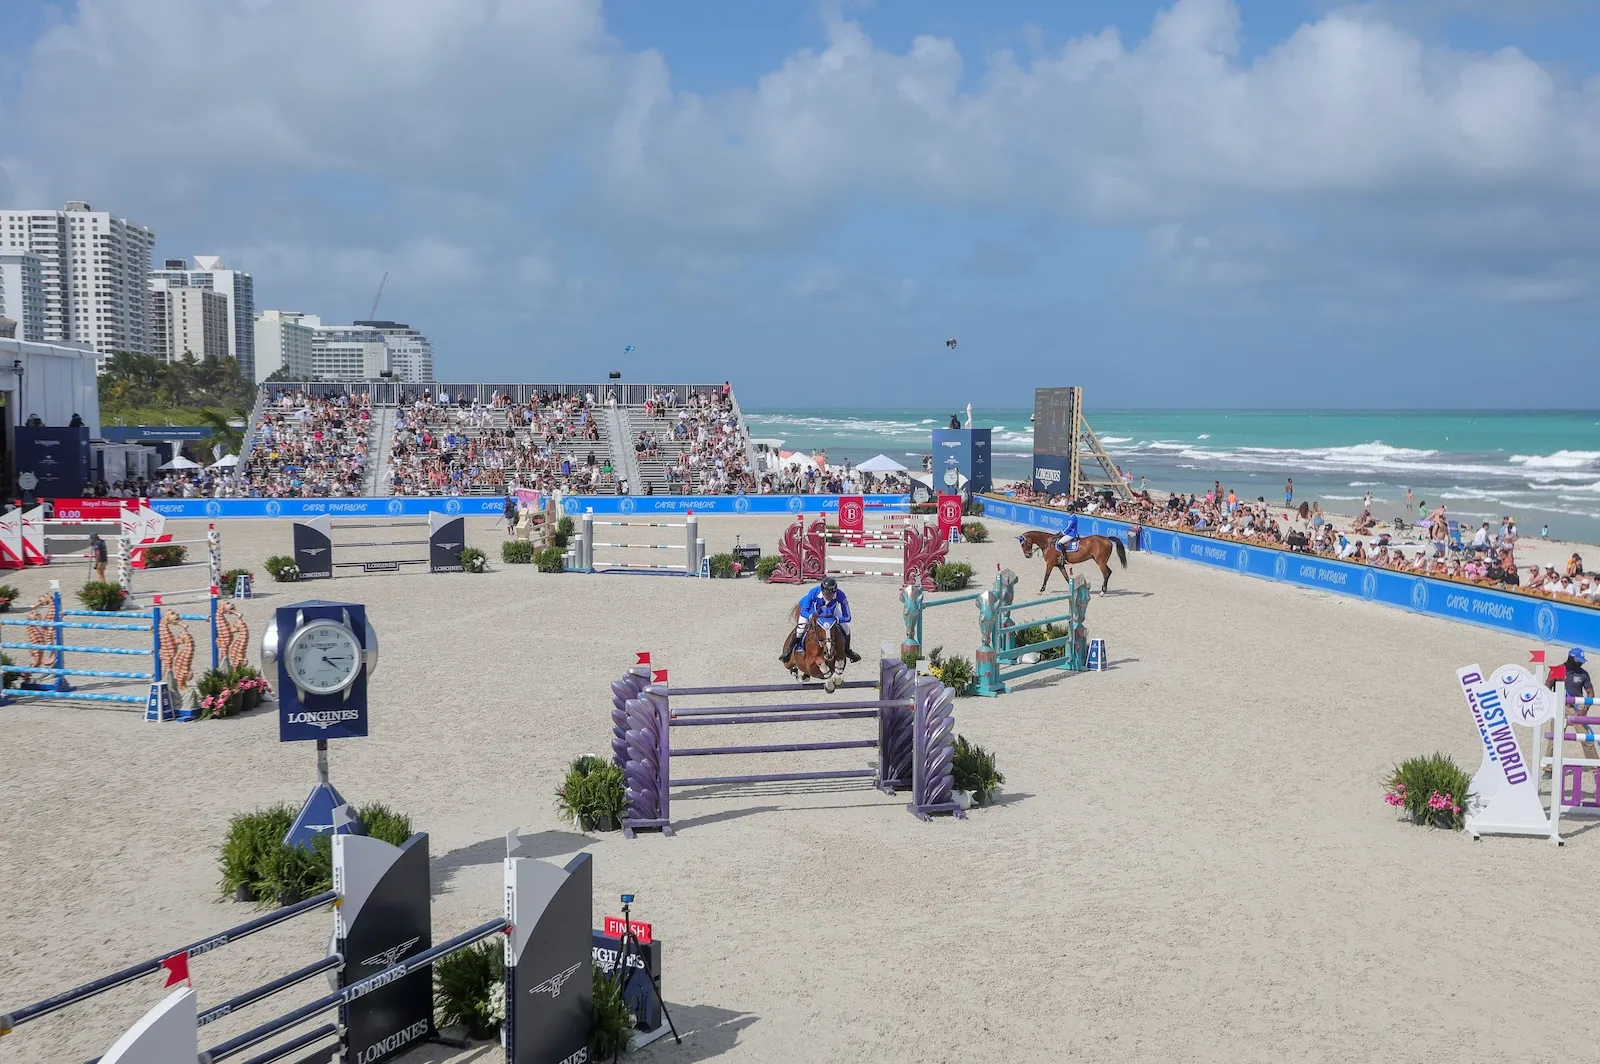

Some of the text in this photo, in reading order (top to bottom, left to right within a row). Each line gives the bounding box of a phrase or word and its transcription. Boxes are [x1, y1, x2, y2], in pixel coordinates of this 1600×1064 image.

[1035, 467, 1061, 482] LONGINES
[303, 503, 368, 512] CAIRO PHARAOHS
[481, 502, 504, 510] CAIRO
[654, 501, 716, 509] CAIRO PHARAOHS
[822, 500, 839, 508] CAIR
[59, 510, 80, 518] 0.00
[1300, 565, 1348, 585] CAIRO PHARAOHS
[1446, 594, 1515, 621] CAIRO PHARAOHS
[288, 709, 359, 724] LONGINES
[1476, 689, 1528, 785] JUSTWORLD
[609, 920, 645, 938] FINSH
[341, 964, 407, 1004] LONGINES
[356, 1018, 429, 1064] LONGINES
